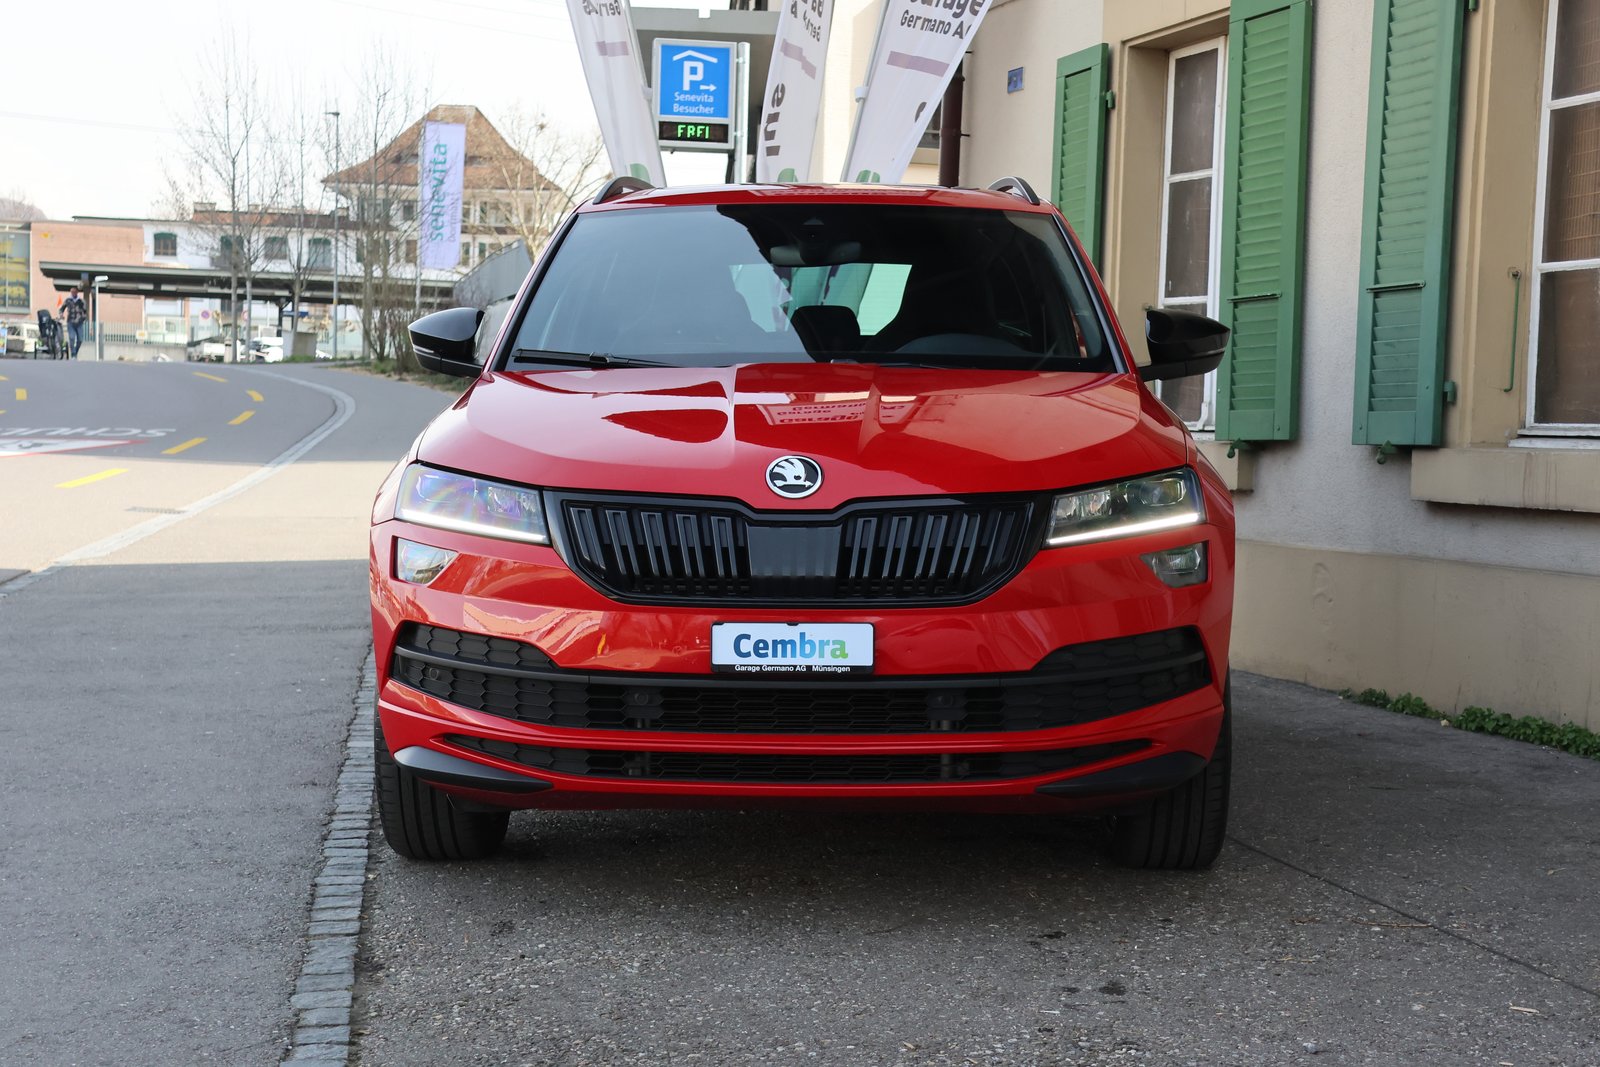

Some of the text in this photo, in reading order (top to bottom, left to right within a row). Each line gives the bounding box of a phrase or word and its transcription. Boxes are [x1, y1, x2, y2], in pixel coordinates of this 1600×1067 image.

[900, 9, 972, 39] Germano A
[683, 61, 704, 91] P
[674, 92, 714, 103] Senevita
[673, 103, 714, 114] Besucher
[429, 143, 447, 241] senevita
[0, 427, 177, 438] SCHUL
[733, 632, 849, 659] Cembra
[735, 665, 760, 673] Garage
[812, 664, 851, 673] Münsingen
